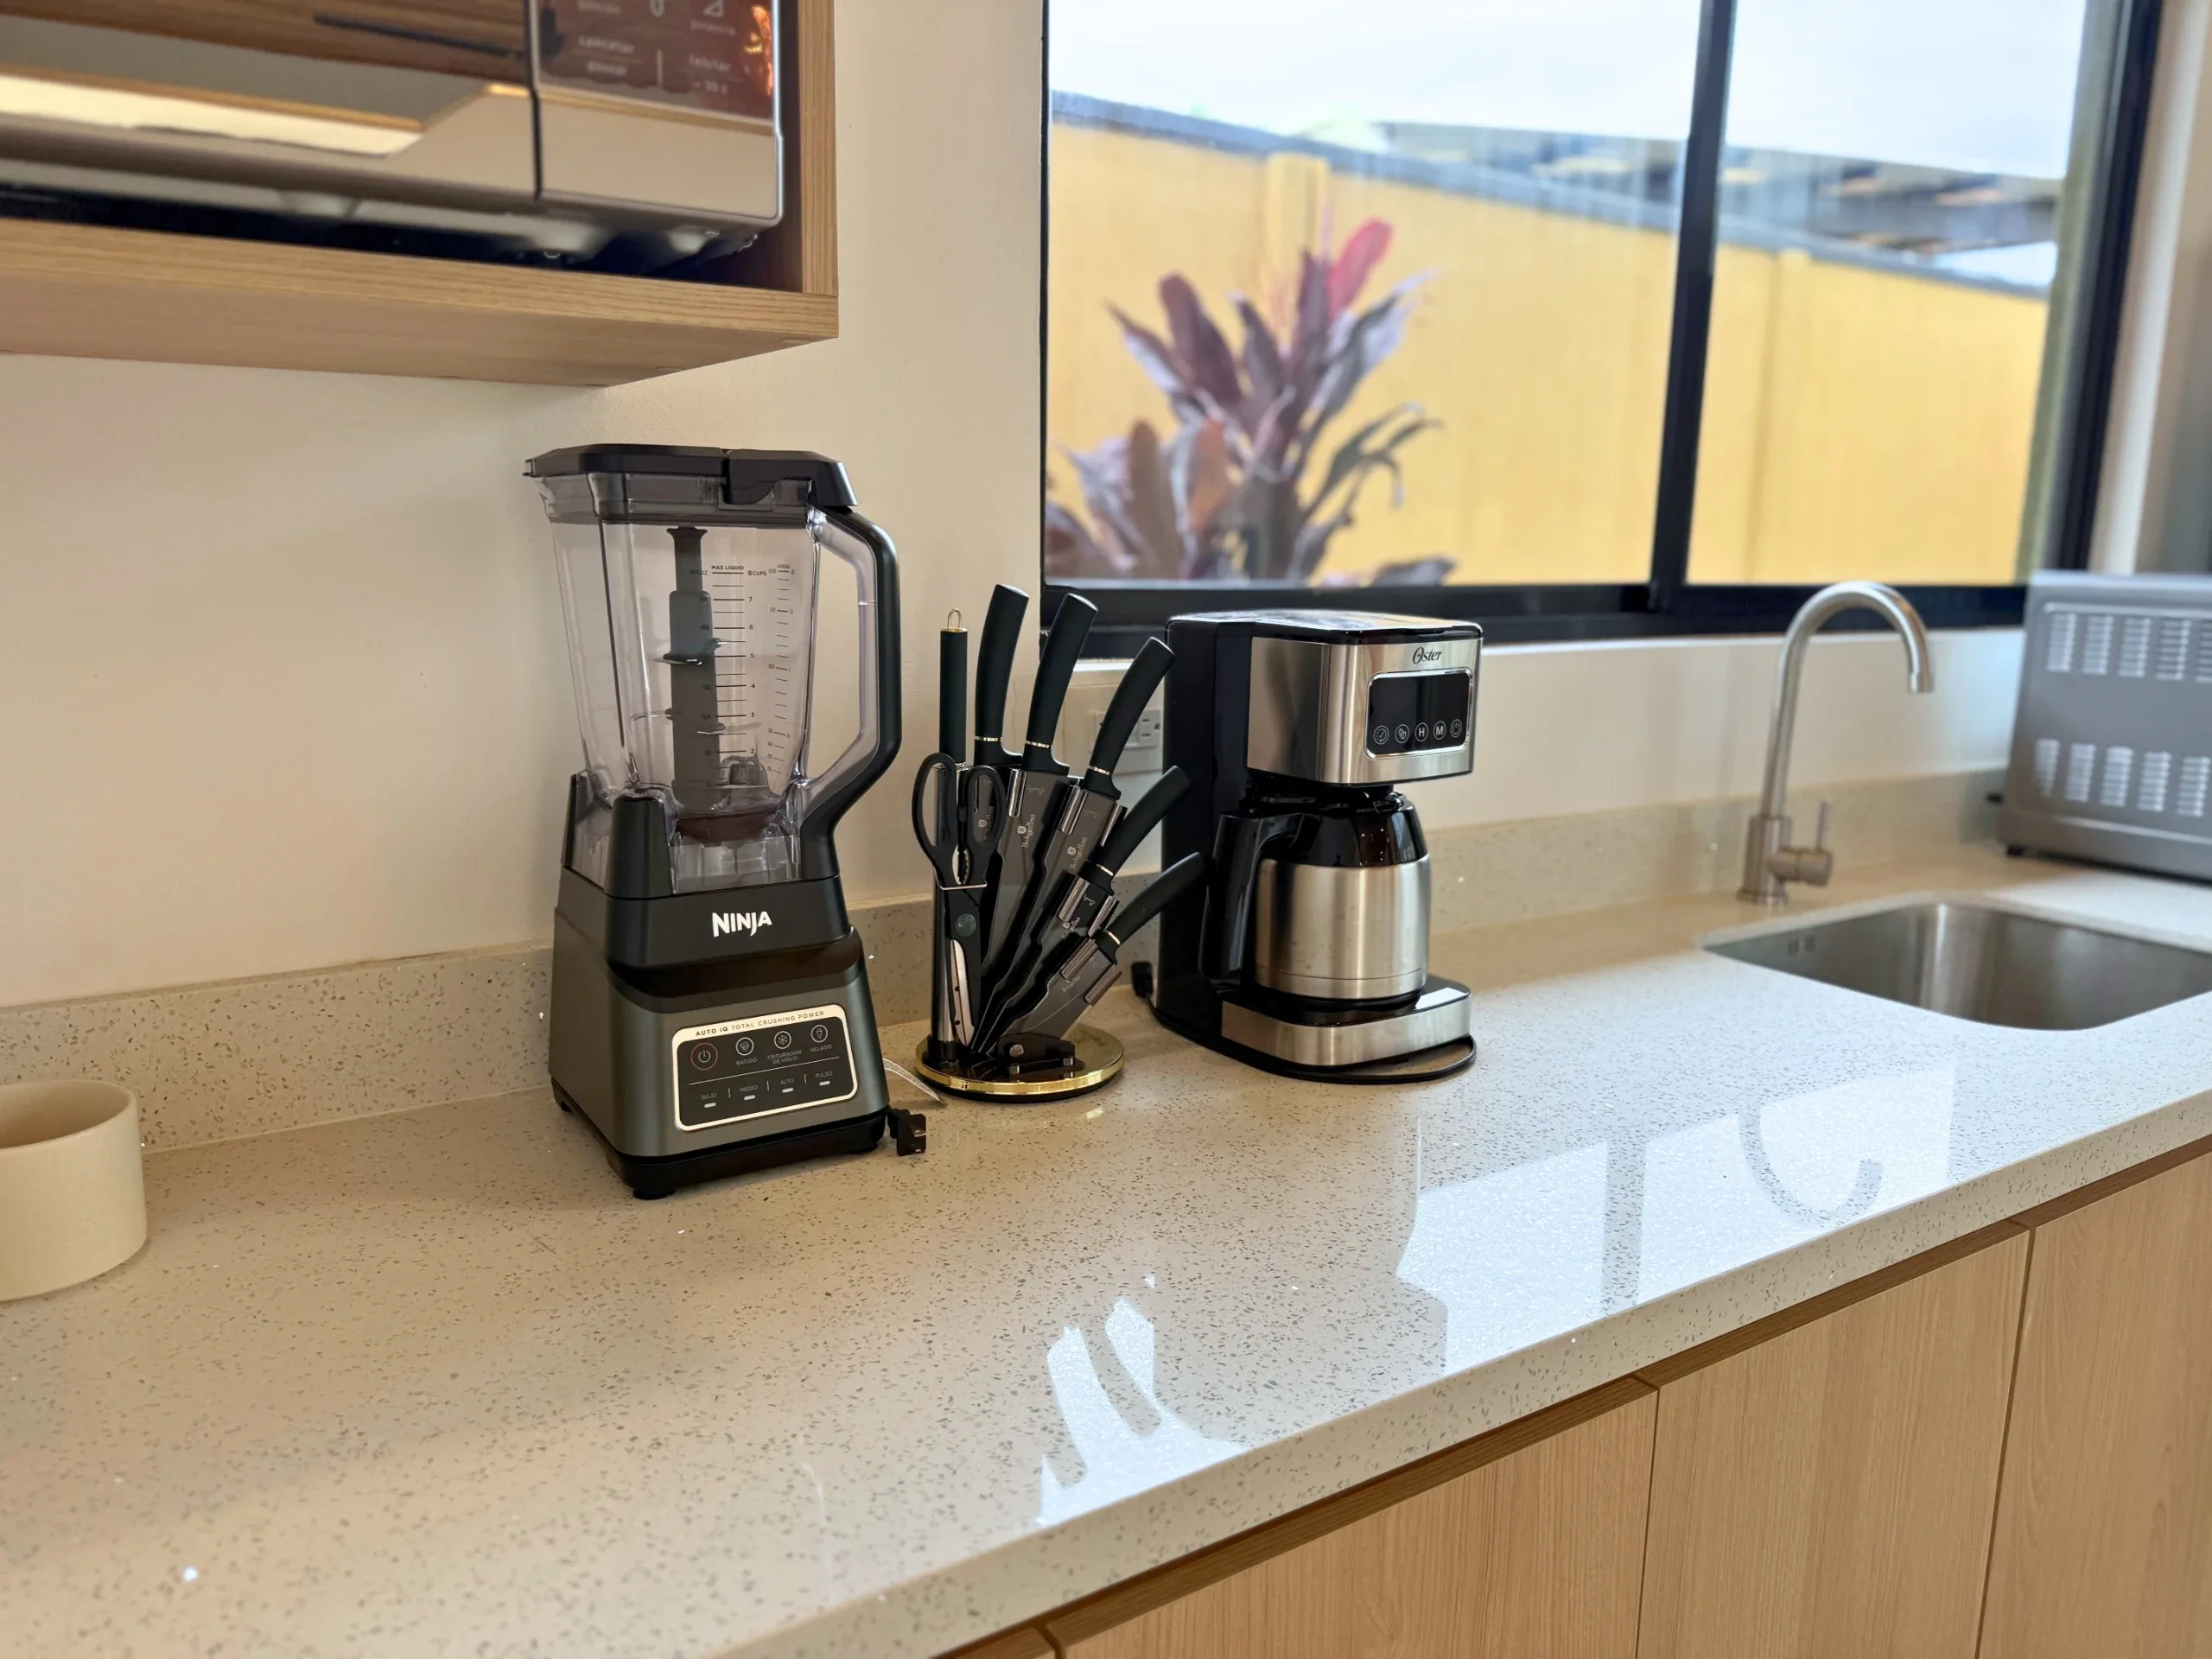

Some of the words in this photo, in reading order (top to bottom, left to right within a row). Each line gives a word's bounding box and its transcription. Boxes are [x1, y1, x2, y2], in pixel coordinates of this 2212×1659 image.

[1413, 647, 1442, 664] Oster
[712, 911, 773, 938] NINJA
[696, 1028, 716, 1037] AUTO
[731, 1021, 755, 1031] TOTAL
[758, 1015, 796, 1027] CRUSHING
[798, 1010, 825, 1020] POWER
[810, 1044, 833, 1052] HELADO
[766, 1049, 803, 1060] TRITURADOR
[781, 1055, 798, 1064] HIELO
[736, 1057, 758, 1066] BATIDO
